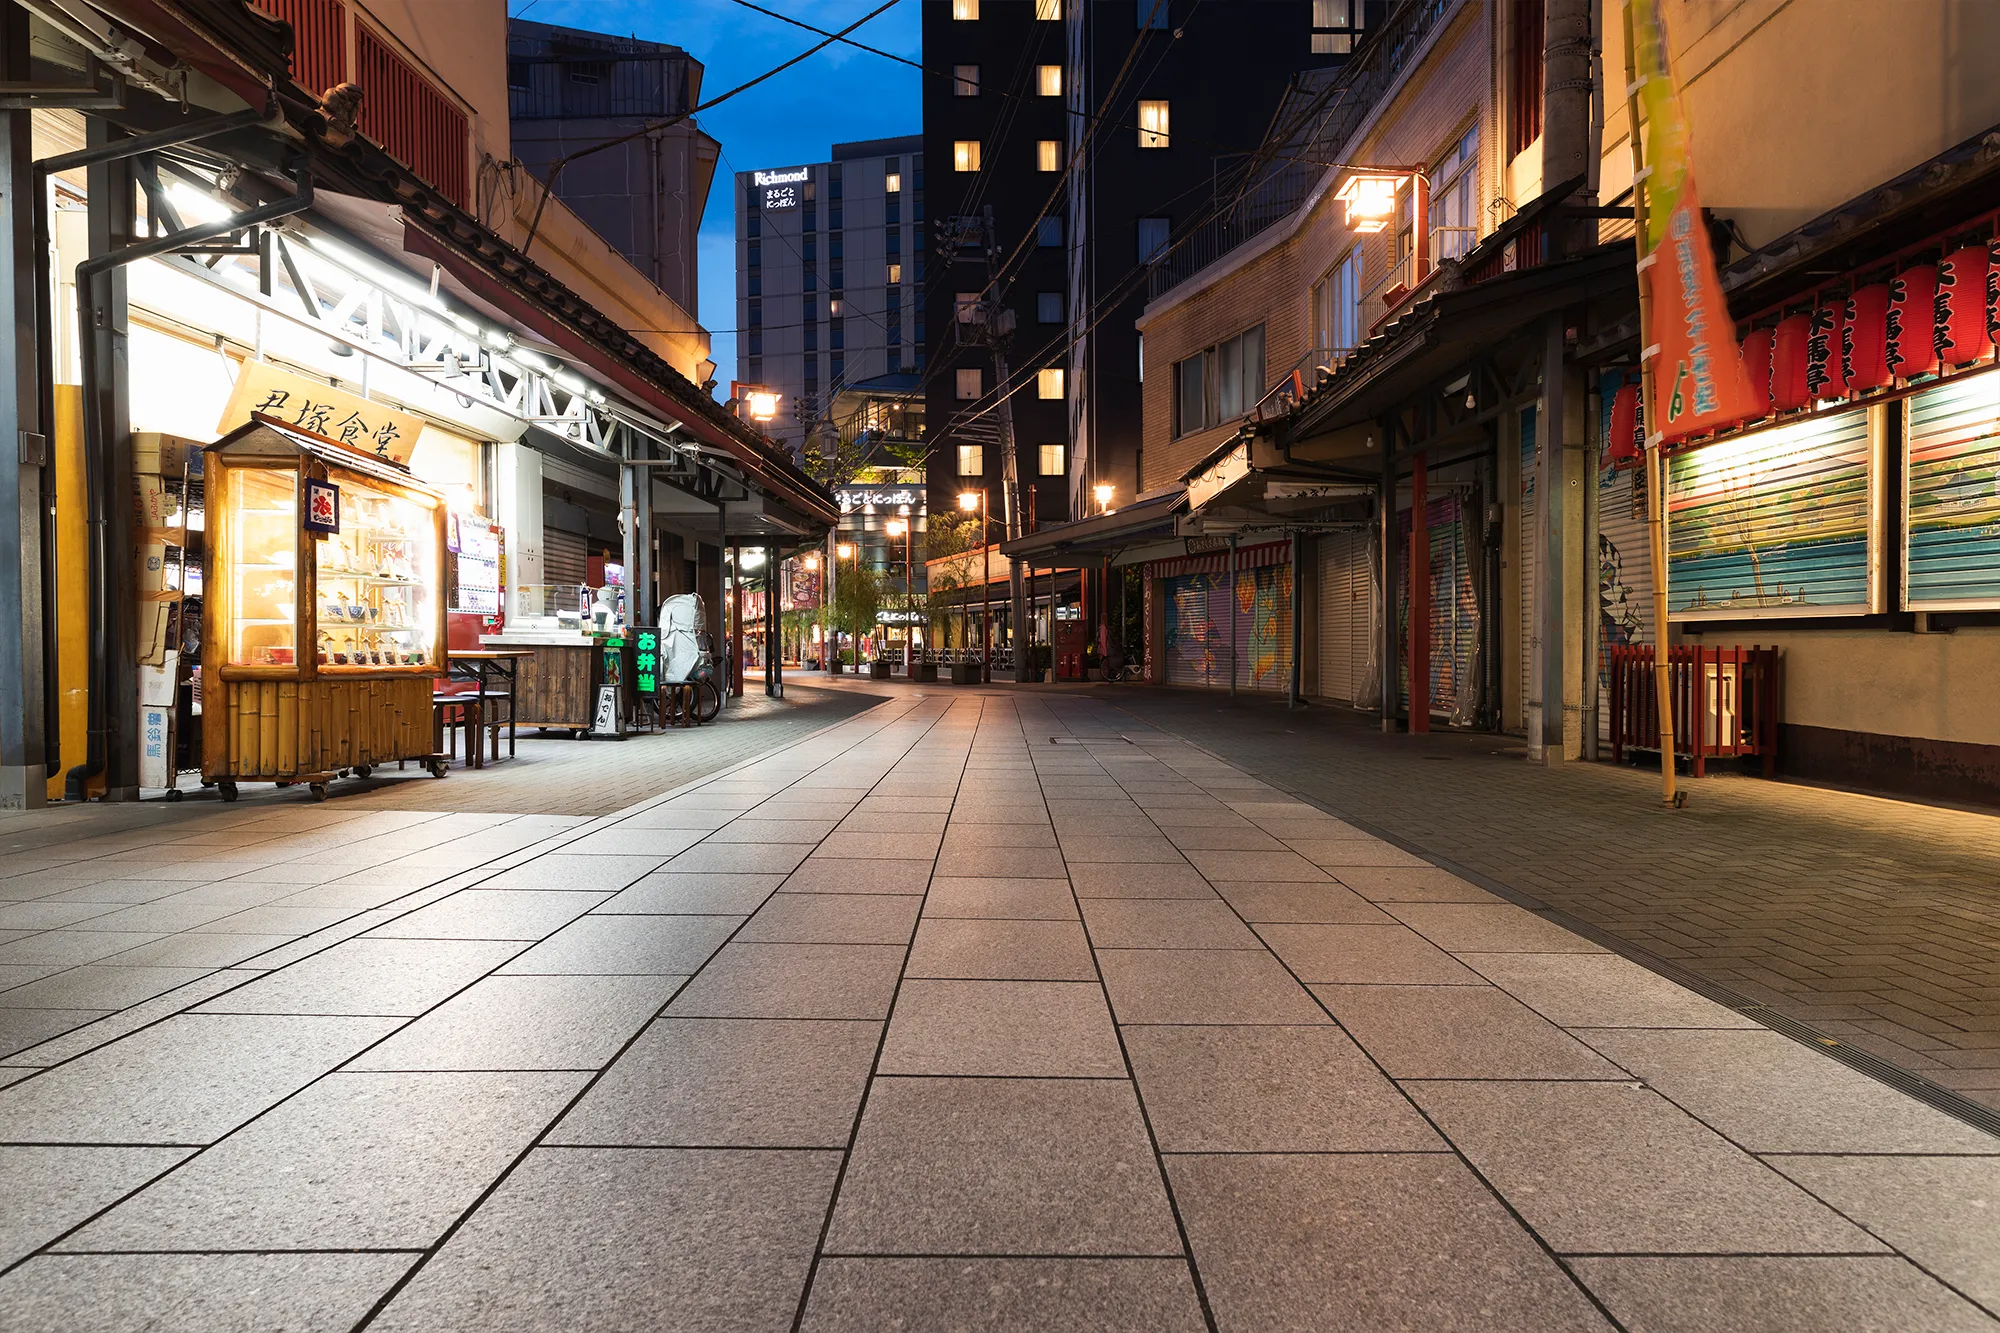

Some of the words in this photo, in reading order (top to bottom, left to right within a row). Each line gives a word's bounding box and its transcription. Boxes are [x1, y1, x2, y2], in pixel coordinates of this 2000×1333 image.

[754, 167, 808, 187] Richmond
[766, 187, 795, 199] まるごと
[766, 198, 796, 209] にっぽん
[1806, 307, 1835, 395] 木馬亭
[637, 632, 656, 692] お弁当
[596, 692, 613, 725] おでん
[146, 712, 162, 758] 馬鈴薯
